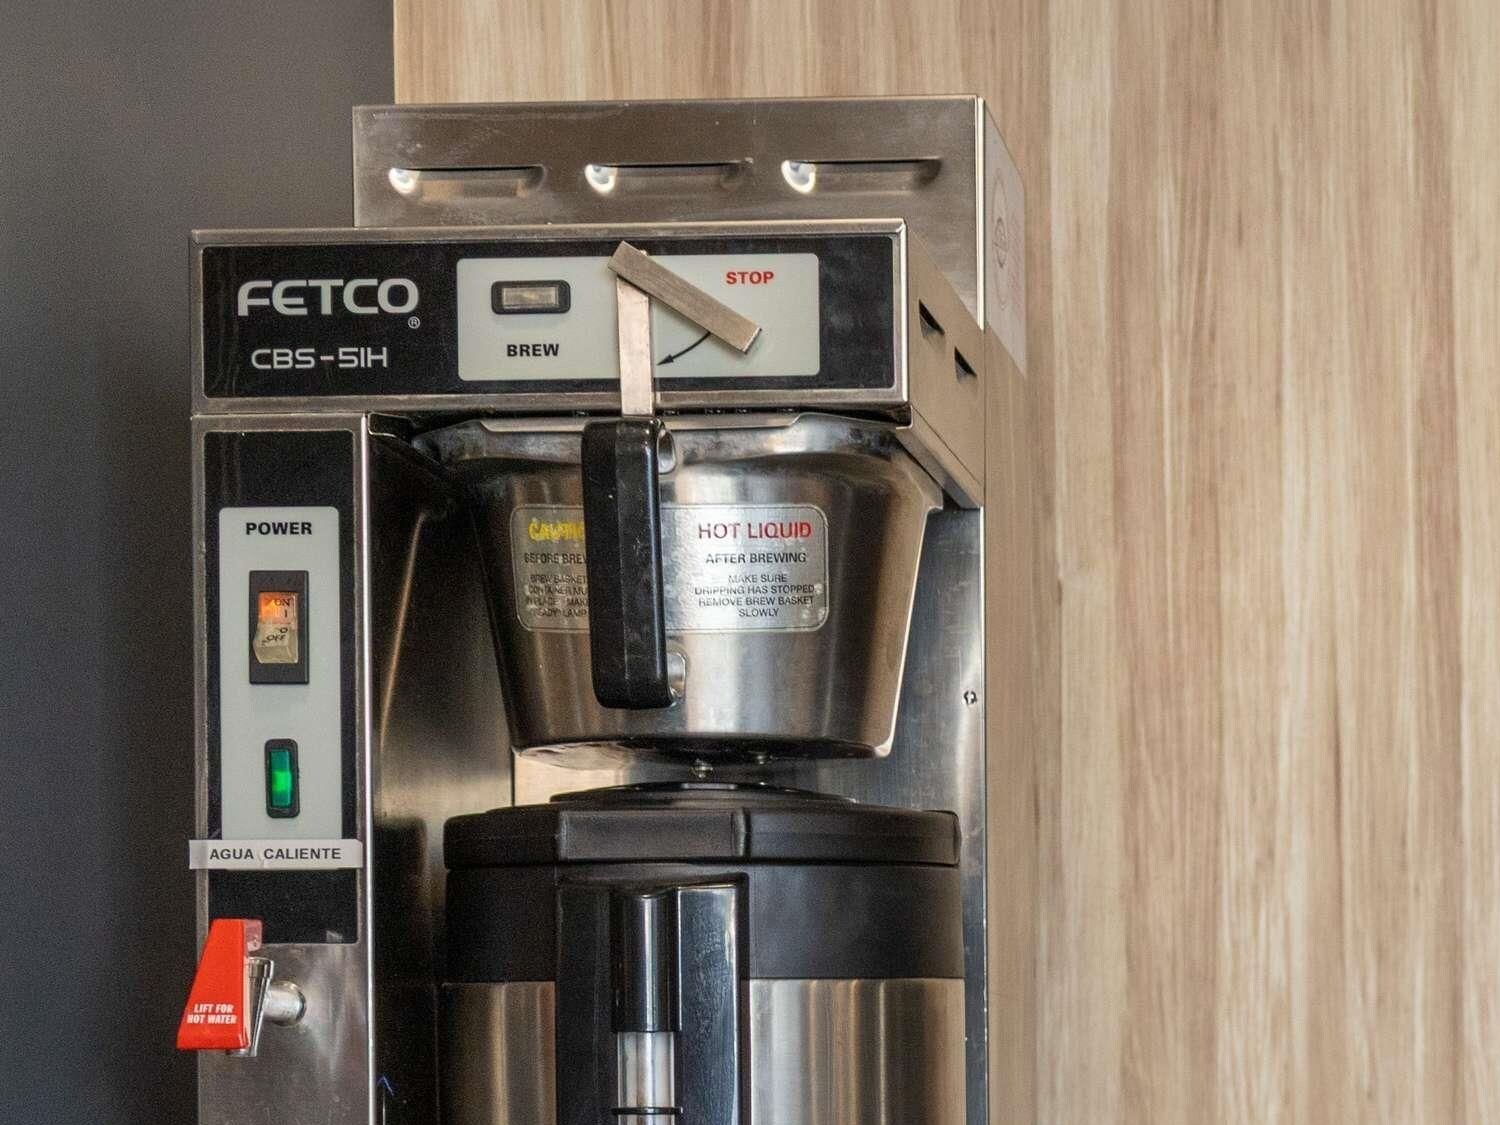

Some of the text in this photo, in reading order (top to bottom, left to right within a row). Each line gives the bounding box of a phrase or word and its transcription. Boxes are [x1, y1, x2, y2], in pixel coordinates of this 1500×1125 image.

[726, 271, 775, 285] STOP
[237, 277, 420, 317] FETCO
[505, 343, 560, 358] BREW
[245, 521, 313, 536] POWER
[698, 521, 813, 539] HOT LIQUID
[524, 552, 587, 564] BEFORE BRE
[705, 552, 807, 564] AFTER BREWING
[728, 572, 789, 584] MAKE SURE
[693, 585, 745, 596] DRIPPING
[747, 585, 769, 595] HAS
[698, 595, 815, 607] REMOVE BREW BASKET
[738, 607, 780, 618] SLOWLY
[209, 847, 342, 861] AGUA CALIENTE
[193, 1003, 235, 1014] LIFT FOR
[187, 1014, 238, 1024] HOT WATER
